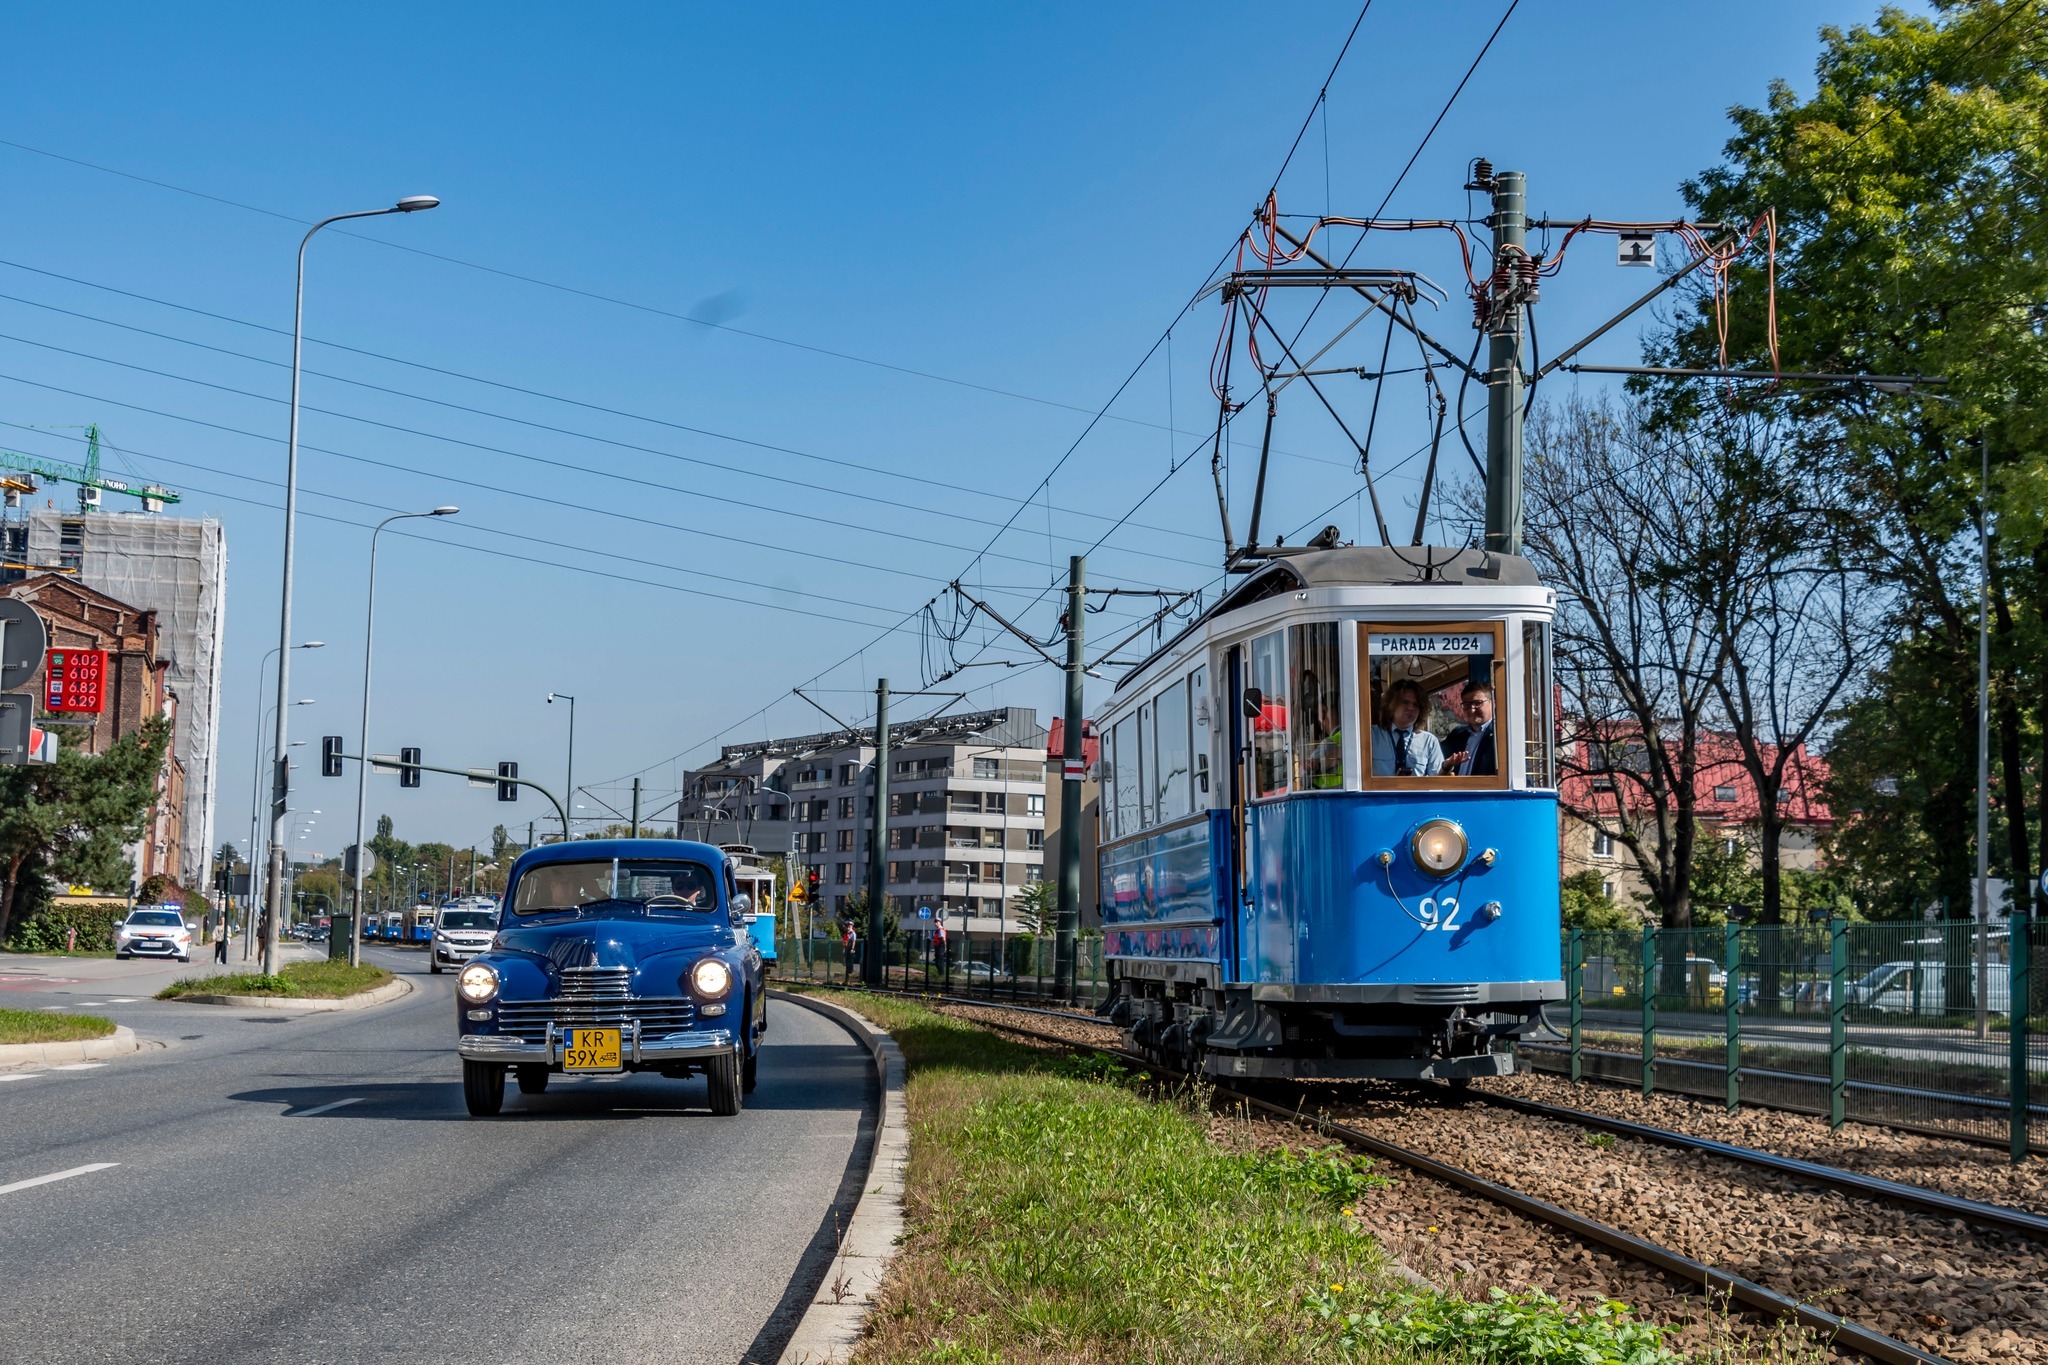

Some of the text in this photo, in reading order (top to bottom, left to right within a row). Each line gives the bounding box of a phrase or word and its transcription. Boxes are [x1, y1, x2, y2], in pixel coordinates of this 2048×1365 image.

[105, 479, 127, 491] NOHO
[1381, 637, 1479, 652] PARADA 2024
[70, 654, 99, 666] 6.02
[69, 681, 97, 694] 6.82
[68, 695, 96, 707] 6.29
[1419, 897, 1461, 931] 92
[582, 1031, 605, 1048] KR
[567, 1050, 598, 1066] 59X
